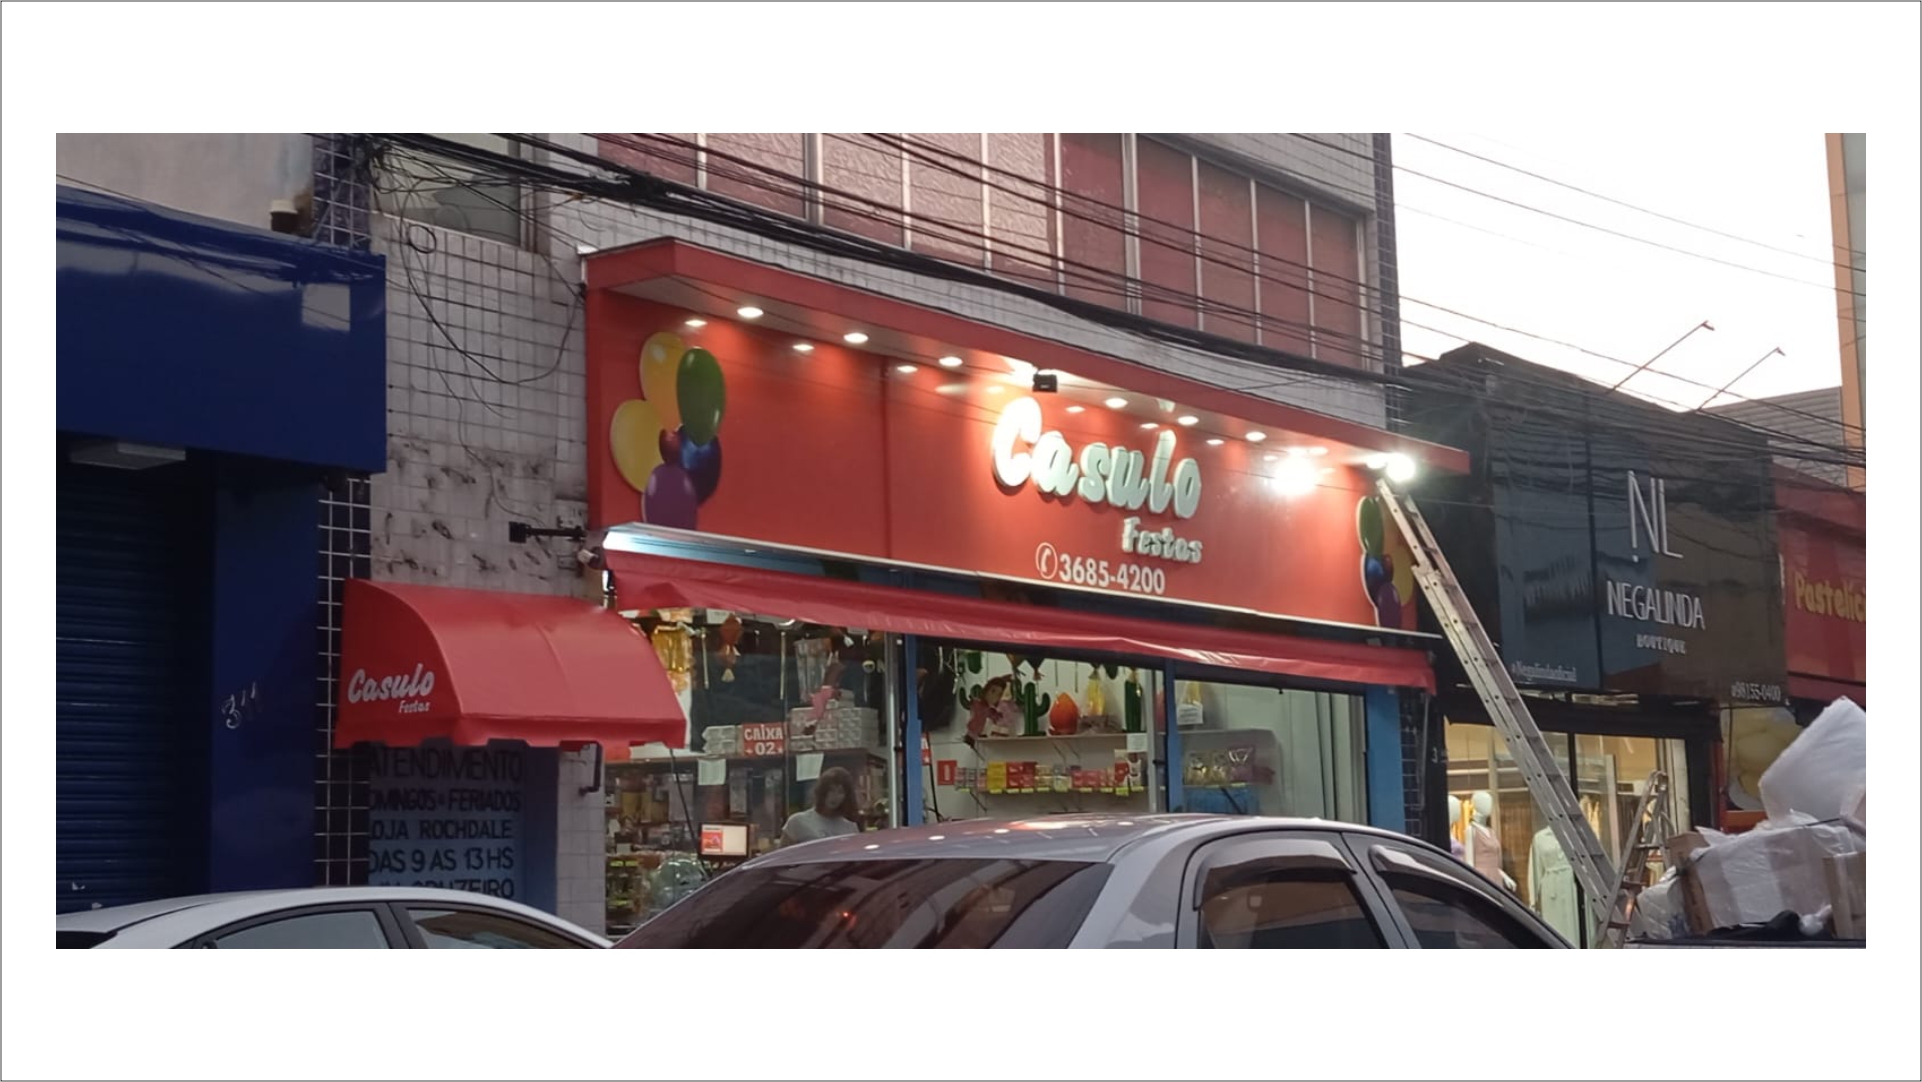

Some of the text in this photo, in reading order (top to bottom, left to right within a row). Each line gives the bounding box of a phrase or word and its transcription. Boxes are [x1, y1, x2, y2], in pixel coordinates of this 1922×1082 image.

[991, 397, 1202, 519] Casulo
[1627, 470, 1684, 563] NL
[1121, 516, 1203, 563] Festas
[1059, 553, 1165, 594] 3685-4200
[1607, 580, 1706, 630] NEGALINDA
[1636, 634, 1687, 655] BOUTIQUE
[348, 663, 435, 704] Casulo
[398, 700, 431, 713] Festas
[744, 724, 784, 741] CAIXA
[755, 741, 777, 756] 02
[369, 819, 513, 840] OJA ROCHDALE
[411, 848, 426, 873] 9
[429, 848, 457, 872] AS
